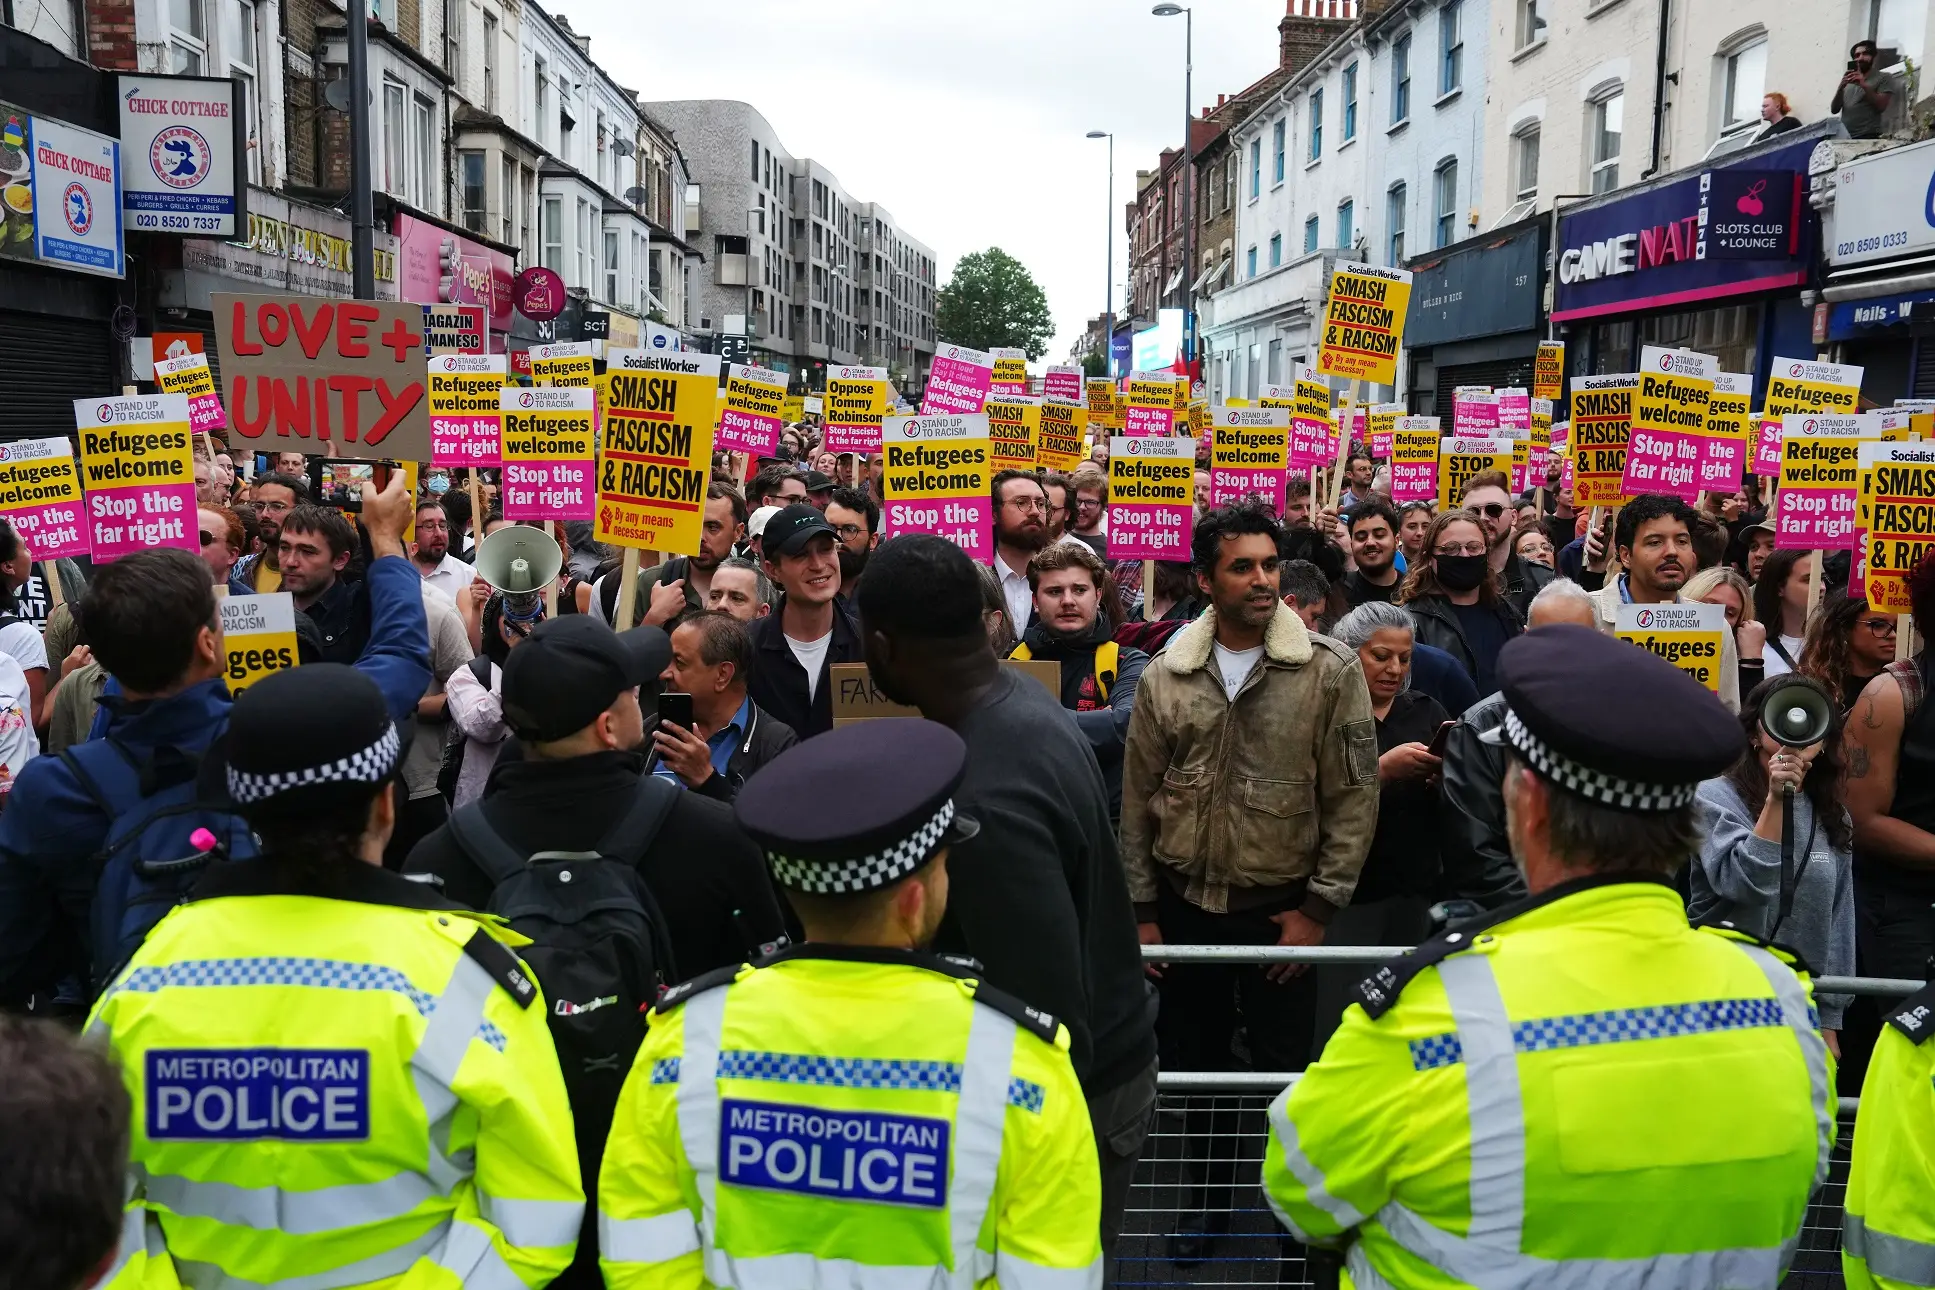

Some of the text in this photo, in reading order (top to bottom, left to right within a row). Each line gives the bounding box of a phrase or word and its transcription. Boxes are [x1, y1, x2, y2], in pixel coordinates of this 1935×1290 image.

[129, 98, 228, 117] CHICK COTTAGE
[38, 147, 112, 183] CHICK COTTAGE
[1841, 172, 1855, 184] 161
[137, 215, 221, 229] 020 8520 7337
[1715, 224, 1783, 234] SLOTS CLUB
[1729, 238, 1777, 248] LOUNGE
[1838, 231, 1907, 256] 020 8509 0333
[1559, 233, 1637, 284] GAME
[464, 262, 489, 296] Pepe's
[1335, 276, 1387, 301] SMASH
[1516, 275, 1527, 286] 157
[527, 301, 548, 309] Pepe's
[1450, 292, 1462, 302] RICE
[1330, 301, 1394, 329] FASCISM
[1854, 305, 1886, 323] Nails
[232, 302, 380, 359] LOVE
[1326, 326, 1397, 355] & RACISM
[936, 359, 950, 368] Say
[958, 363, 974, 373] loud
[1334, 364, 1365, 376] necessary
[1336, 354, 1377, 368] By any means
[934, 367, 976, 383] Say it clear:
[432, 377, 502, 393] Refugees
[609, 375, 677, 412] SMASH
[730, 381, 783, 400] Refugees
[830, 381, 874, 396] Oppose
[930, 376, 983, 399] Refugees
[1642, 377, 1709, 406] Refugees
[433, 395, 499, 411] welcome
[535, 392, 558, 400] STAND
[535, 400, 574, 408] TO RACISM
[728, 397, 778, 413] welcome
[830, 396, 872, 411] Tommy
[928, 391, 977, 411] welcome
[232, 375, 425, 446] UNITY
[829, 410, 882, 423] Robinson
[1640, 406, 1703, 428] welcome
[433, 420, 498, 439] Stop the
[506, 415, 589, 436] Refugees
[724, 413, 772, 432] Stop the
[829, 426, 878, 436] Stop fascists
[922, 419, 962, 429] STAND UP
[923, 426, 967, 436] TO RACISM
[85, 431, 186, 456] Refugees
[506, 436, 585, 454] welcome
[606, 419, 692, 458] FASCISM
[722, 427, 770, 446] far right
[829, 436, 834, 444] &
[836, 436, 849, 444] the
[864, 438, 882, 447] right
[1217, 430, 1284, 448] Refugees
[1396, 434, 1436, 447] Refugees
[433, 439, 498, 458] far right
[1216, 448, 1280, 463] welcome
[1395, 447, 1433, 458] welcome
[1633, 433, 1697, 461] Stop the
[888, 446, 985, 469] Refugees
[1450, 456, 1494, 472] STOP
[89, 458, 183, 480] welcome
[508, 466, 583, 486] Stop the
[1114, 461, 1190, 481] Refugees
[1395, 465, 1431, 479] Stop the
[1630, 459, 1694, 486] far right
[602, 460, 703, 503] & RACISM
[890, 471, 981, 492] welcome
[1114, 481, 1185, 499] welcome
[1215, 471, 1276, 490] Stop the
[1410, 480, 1430, 492] right
[92, 491, 182, 519] Stop the
[508, 487, 583, 508] far right
[1782, 492, 1826, 515] Stop
[615, 507, 674, 527] By any means
[890, 503, 979, 530] Stop the
[1112, 508, 1181, 528] Stop the
[1781, 516, 1810, 533] far
[95, 518, 184, 546] far right
[613, 525, 655, 543] necessary
[1112, 528, 1180, 549] far right
[1656, 610, 1697, 619] STAND UP
[1657, 619, 1700, 629] TO RACISM
[156, 1057, 360, 1081] METROPOLITAN
[156, 1085, 359, 1131] POLICE
[730, 1107, 939, 1149] METROPOLITAN
[728, 1134, 936, 1198] POLICE
